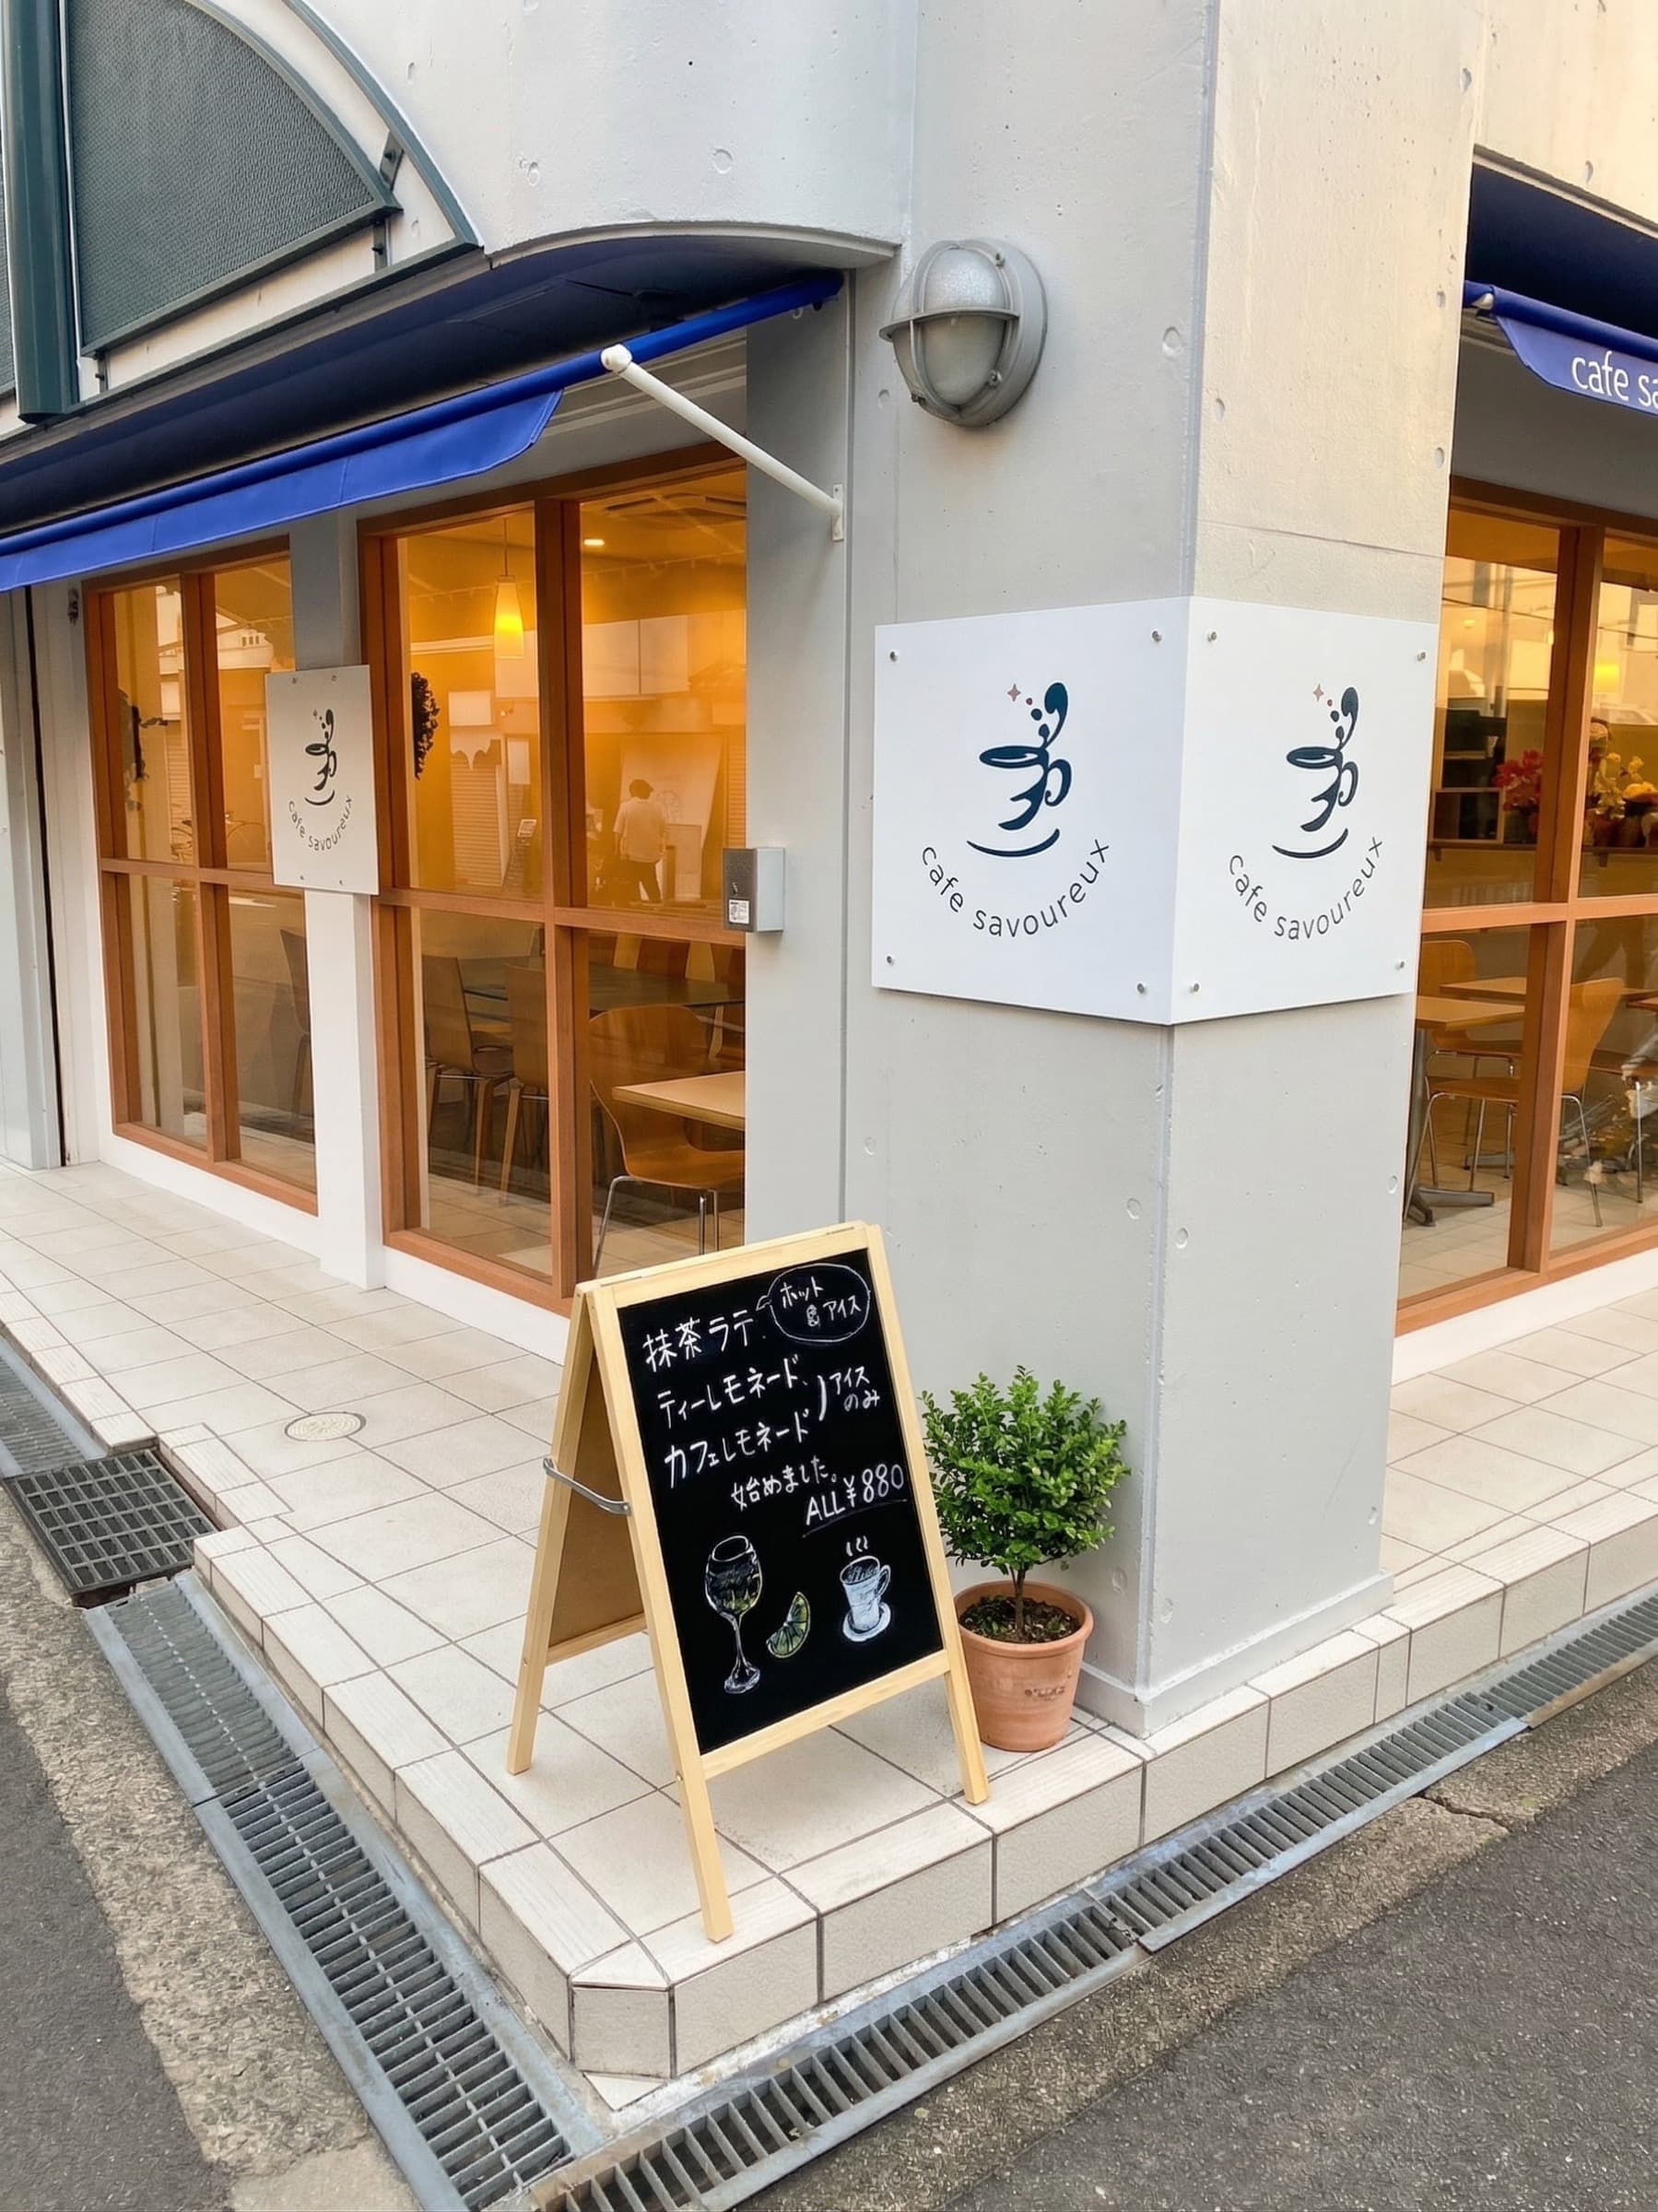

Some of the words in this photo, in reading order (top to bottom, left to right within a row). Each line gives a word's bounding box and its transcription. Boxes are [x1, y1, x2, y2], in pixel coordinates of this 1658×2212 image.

[972, 839, 1110, 937] savoureux
[1274, 837, 1382, 940] savoureux
[780, 1276, 824, 1309] ホット
[642, 1309, 754, 1372] 抹茶ラテ
[829, 1366, 870, 1395] アイス
[843, 1388, 881, 1412] のみ
[664, 1407, 809, 1489] カフェレモネード
